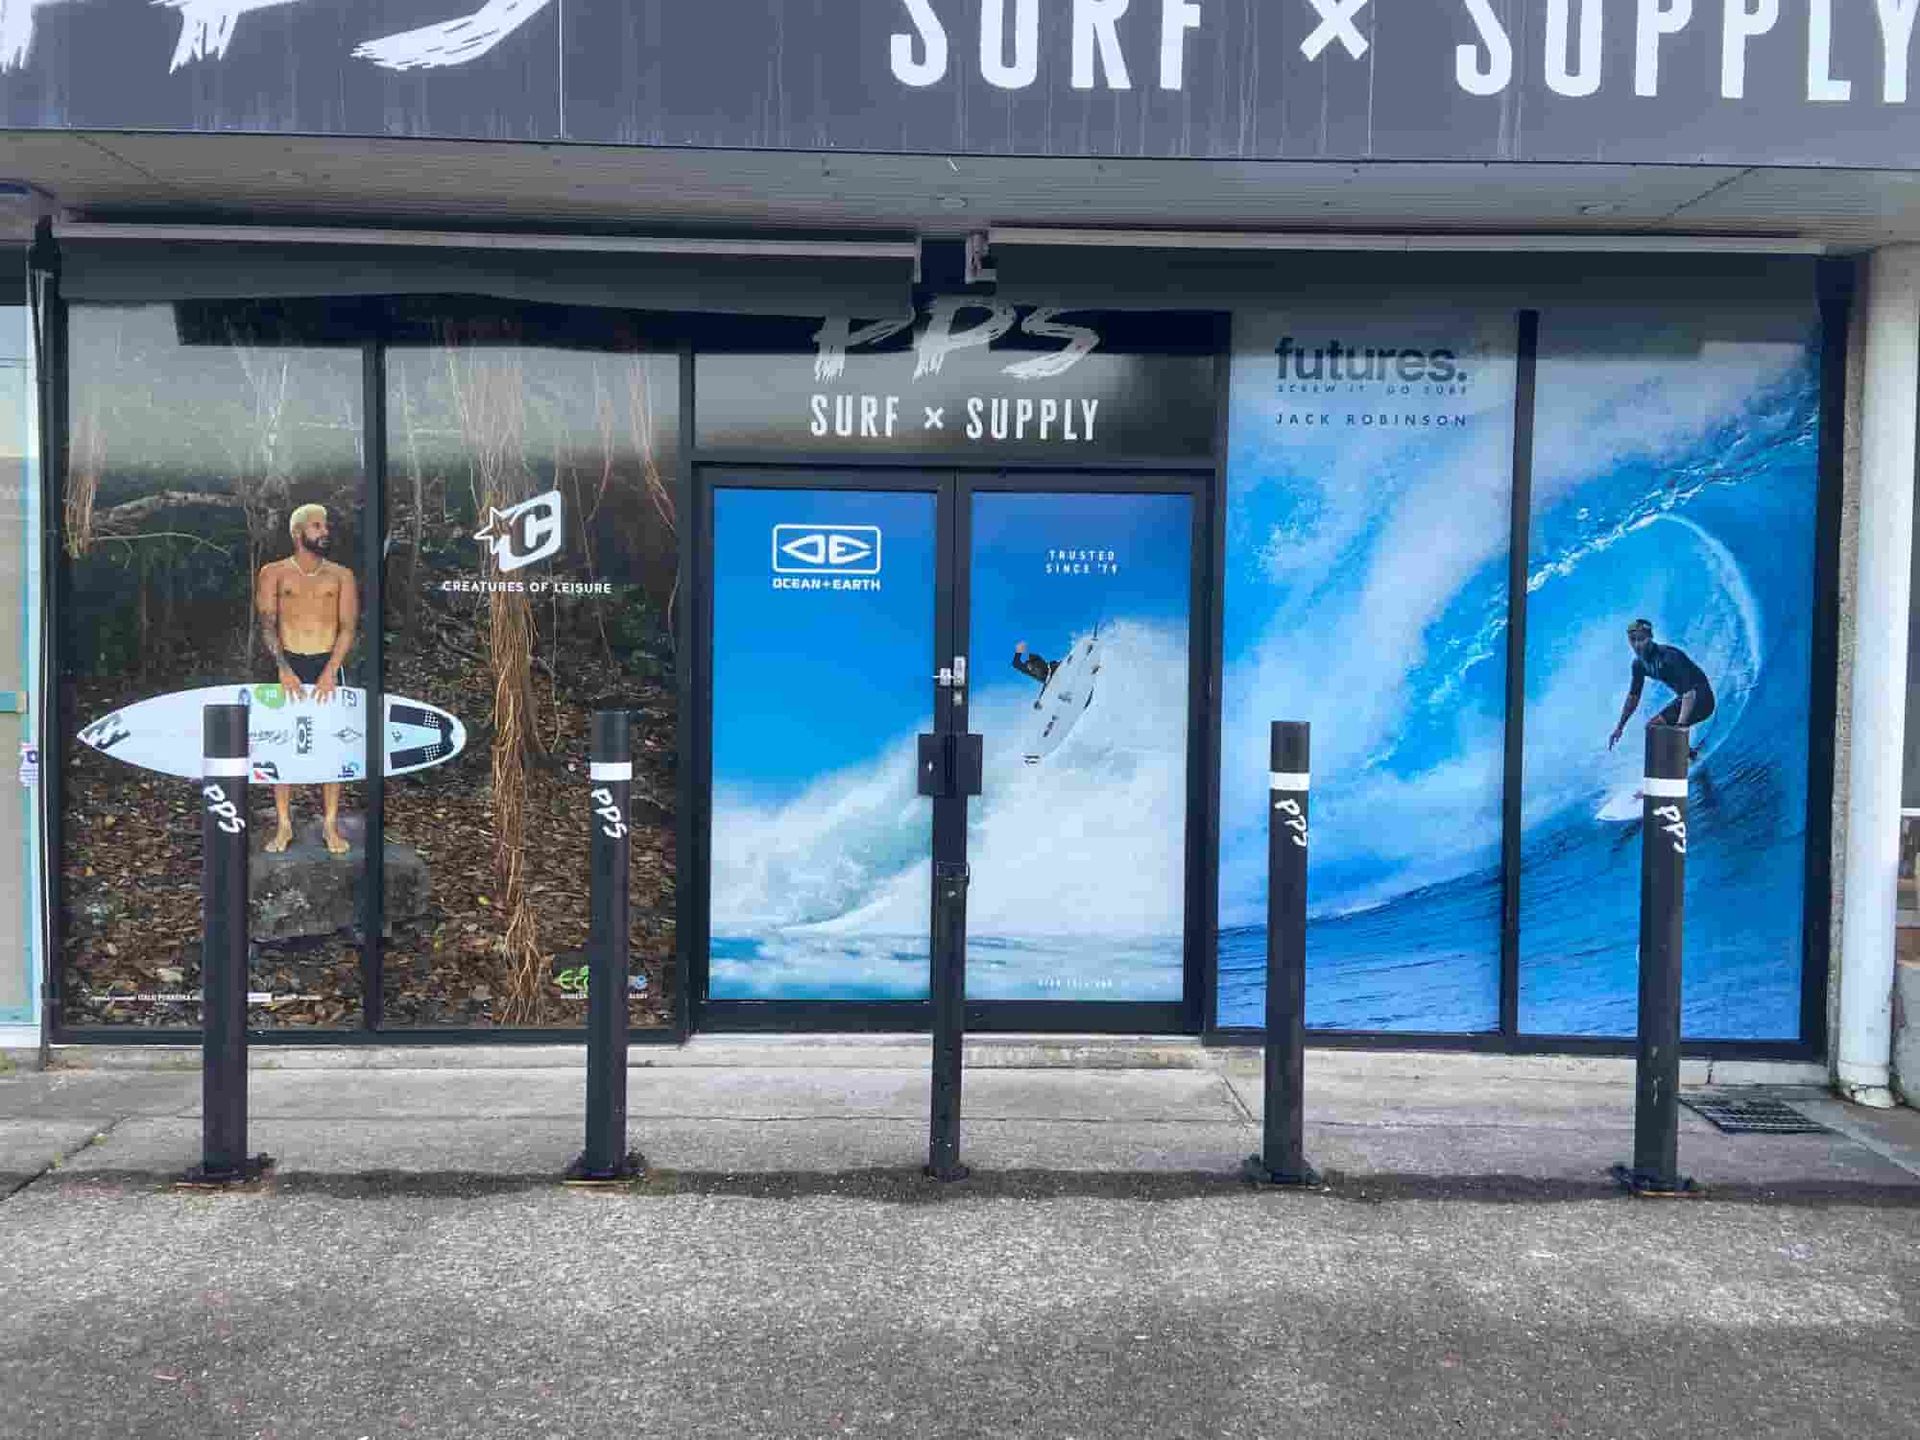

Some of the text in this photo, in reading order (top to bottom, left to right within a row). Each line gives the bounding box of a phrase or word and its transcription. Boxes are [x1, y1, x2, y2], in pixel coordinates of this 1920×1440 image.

[890, 0, 1201, 91] SURF
[1455, 0, 1920, 103] SUPPLY
[1275, 337, 1468, 382] futures.
[810, 394, 900, 438] SURF
[966, 397, 1099, 441] SUPPLY
[1276, 413, 1467, 428] JACK ROBINSON
[1045, 563, 1090, 574] SINCE
[1048, 549, 1115, 561] TRUSTED
[442, 580, 612, 595] CREATURES OF LEISURE
[202, 783, 246, 834] PPS
[590, 788, 628, 839] PPS
